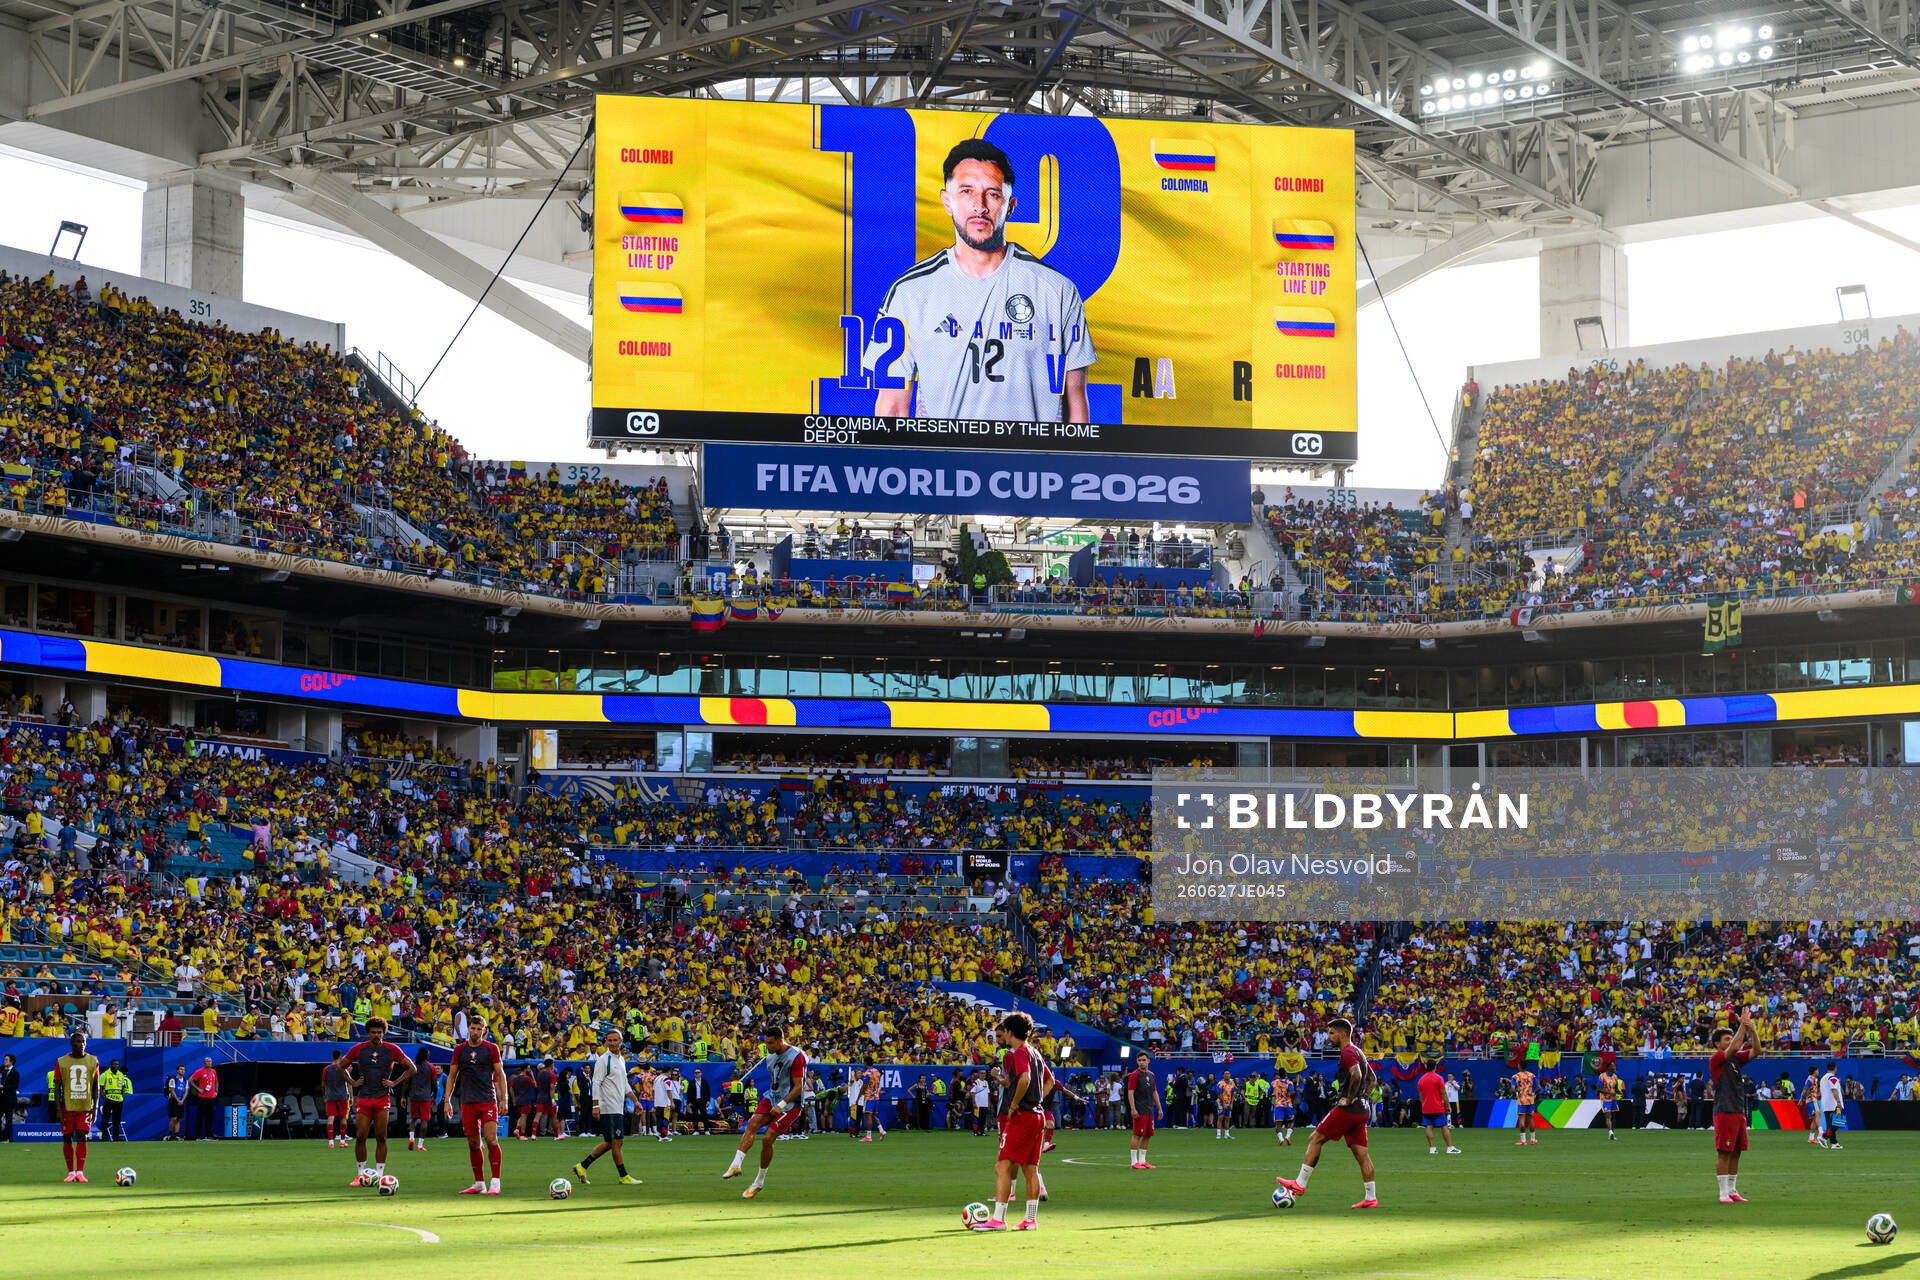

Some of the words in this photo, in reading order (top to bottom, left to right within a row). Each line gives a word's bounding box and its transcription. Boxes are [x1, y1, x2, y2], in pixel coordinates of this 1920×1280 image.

[621, 148, 674, 165] COLOMBI
[1161, 177, 1209, 193] COLOMBIA
[1274, 176, 1324, 193] COLOMBI
[622, 235, 679, 252] STARTING
[628, 253, 654, 268] LINE
[657, 254, 674, 271] UP
[1277, 262, 1331, 278] STARTING
[1283, 279, 1307, 294] LINE
[1310, 280, 1327, 296] UP
[189, 299, 211, 317] 351
[618, 340, 671, 357] COLOMBI
[839, 315, 908, 390] 12
[968, 338, 1005, 384] 12
[1276, 363, 1326, 379] COLOMBI
[629, 415, 657, 432] CC
[804, 415, 890, 433] COLOMBIA,
[895, 418, 990, 435] PRESENTED
[994, 421, 1016, 435] BY
[1018, 422, 1050, 437] THE
[1054, 424, 1100, 438] HOME
[804, 430, 861, 444] DEPOT.
[1293, 436, 1320, 453] CC
[567, 465, 601, 480] 352
[756, 463, 838, 494] FIFA
[843, 466, 981, 497] WORLD
[988, 471, 1063, 500] CUP
[1071, 473, 1200, 504] 2026
[1326, 489, 1357, 504] 355
[8, 1012, 16, 1023] 10
[880, 1070, 902, 1088] IFA
